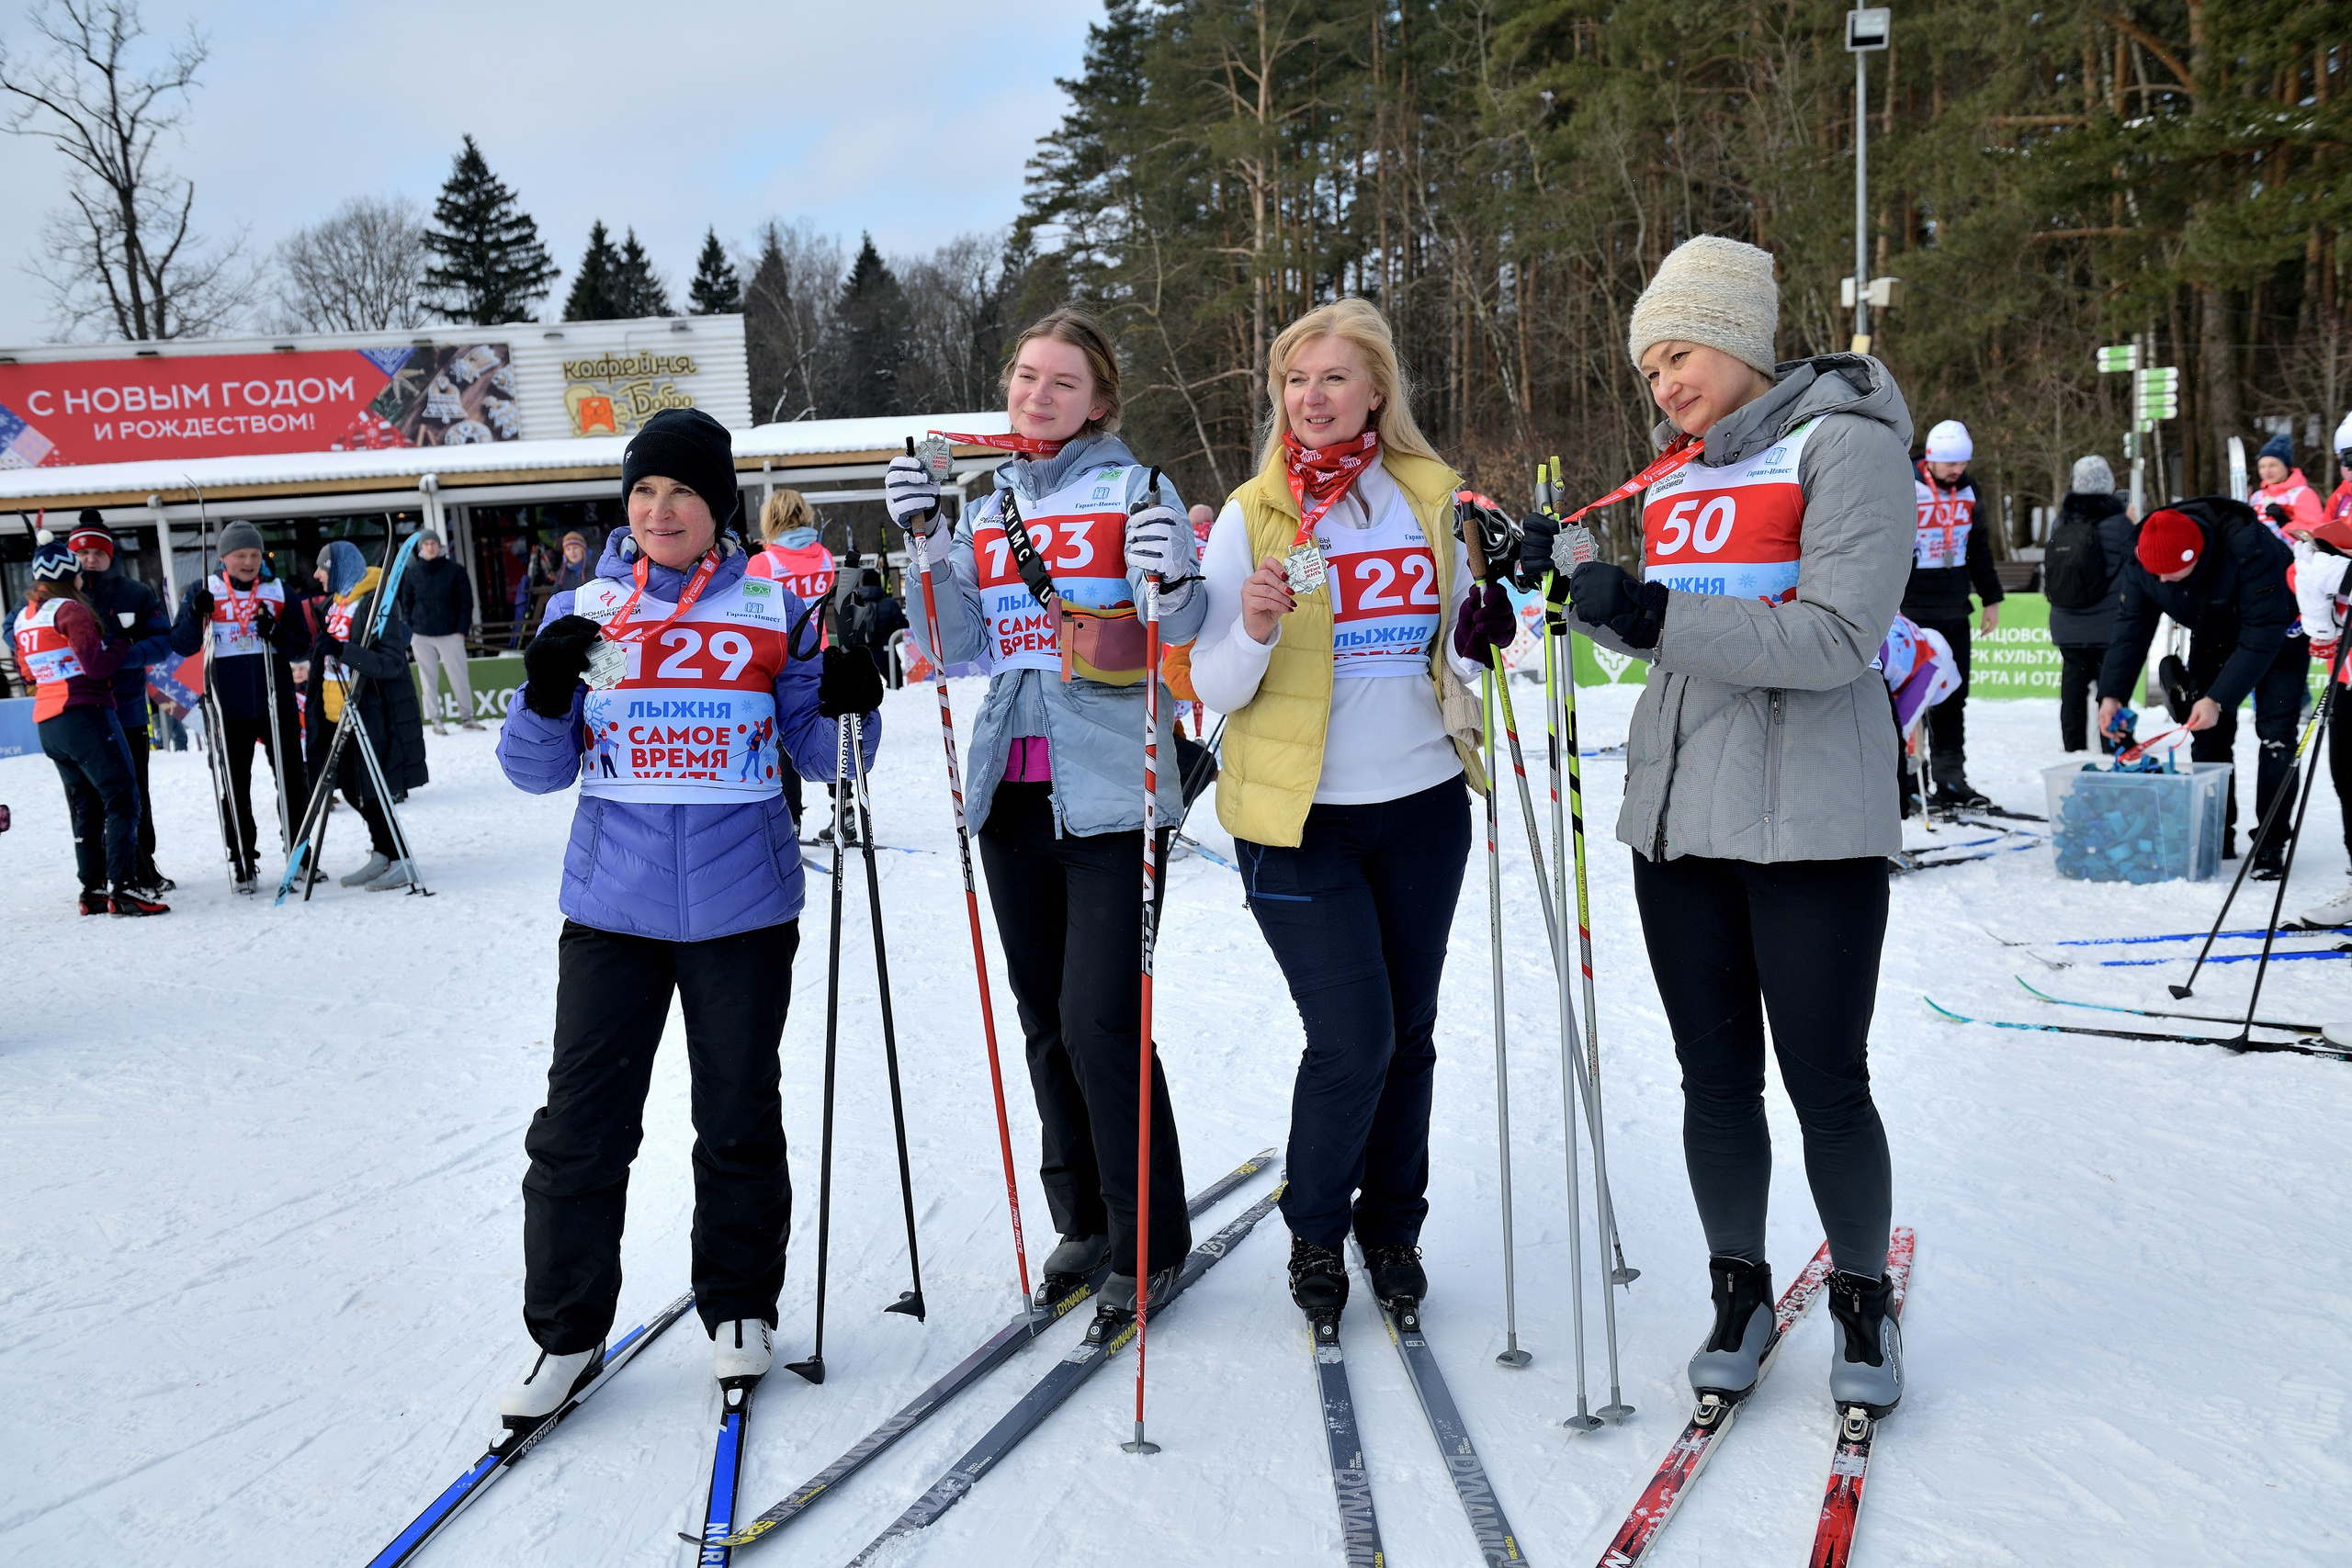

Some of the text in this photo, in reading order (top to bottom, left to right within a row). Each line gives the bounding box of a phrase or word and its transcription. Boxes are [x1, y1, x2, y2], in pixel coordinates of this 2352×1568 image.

[562, 351, 697, 385] кофейня
[28, 377, 356, 416] С НОВЫМ ГОДОМ
[94, 412, 316, 441] И РОЖДЕСТВОМ!
[1746, 468, 1792, 478] Гарант-Инвест
[1656, 495, 1736, 556] 50
[1917, 502, 1970, 527] 704
[985, 520, 1096, 579] 123
[1303, 561, 1319, 570] САМОЕ
[1304, 566, 1320, 574] ВРЕМЯ
[1305, 570, 1322, 579] ЖИТЬ
[786, 574, 827, 596] 116
[1329, 556, 1439, 614] 122
[726, 611, 781, 623] Гарант-Инвест
[19, 629, 39, 653] 97
[1334, 626, 1428, 649] ЛЫЖНЯ
[619, 627, 753, 682] 129
[2014, 671, 2027, 685] И
[628, 701, 731, 719] ЛЫЖНЯ
[628, 726, 731, 746] САМОЕ
[841, 716, 850, 774] NORDWAY
[631, 748, 728, 769] ВРЕМЯ
[1578, 865, 1589, 928] WWW.STC-SKI.RU
[1012, 1206, 1023, 1254] PRO RACE
[1057, 1283, 1091, 1316] DYNAMIC
[521, 1416, 560, 1456] NORDWAY
[1840, 1483, 1849, 1506] FISCHER
